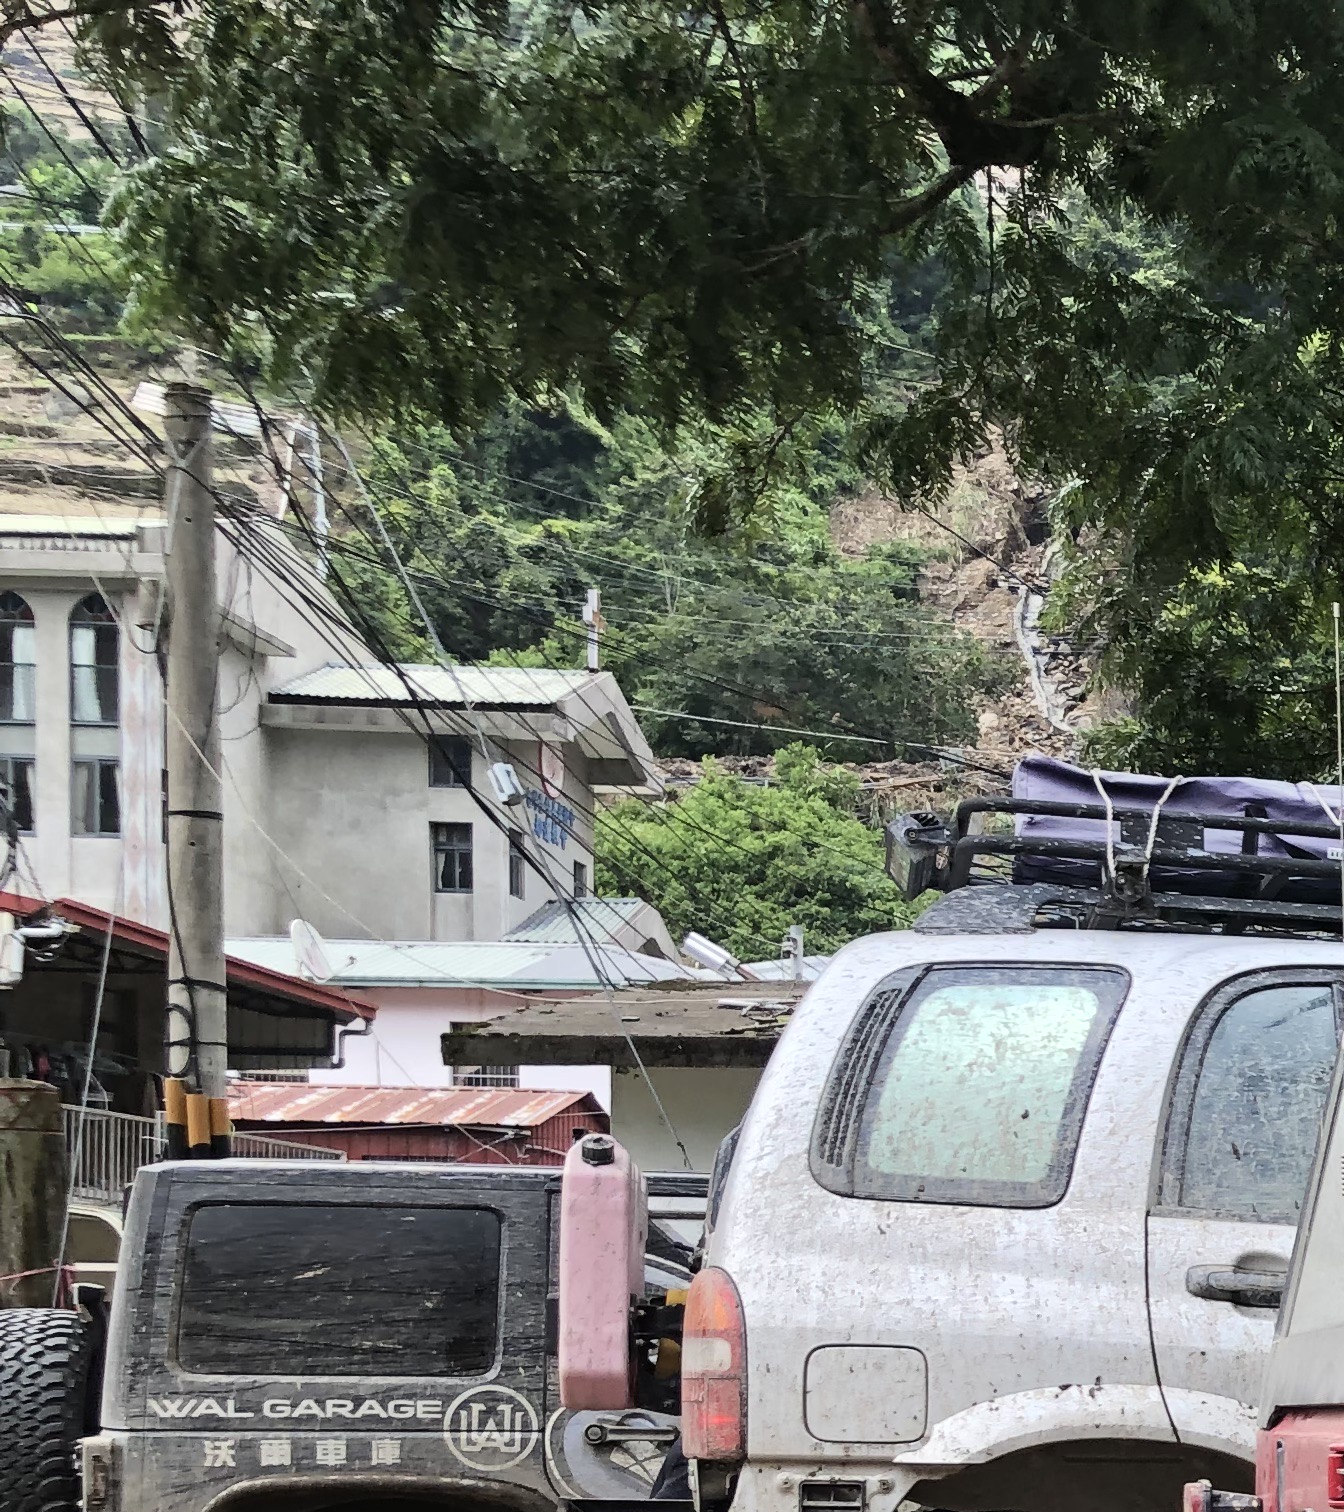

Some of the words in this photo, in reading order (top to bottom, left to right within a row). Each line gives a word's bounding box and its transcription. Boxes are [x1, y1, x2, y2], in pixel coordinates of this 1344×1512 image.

[146, 1398, 255, 1418] WAL
[262, 1398, 443, 1419] GARAGE
[203, 1439, 402, 1467] 沃爾車庫
